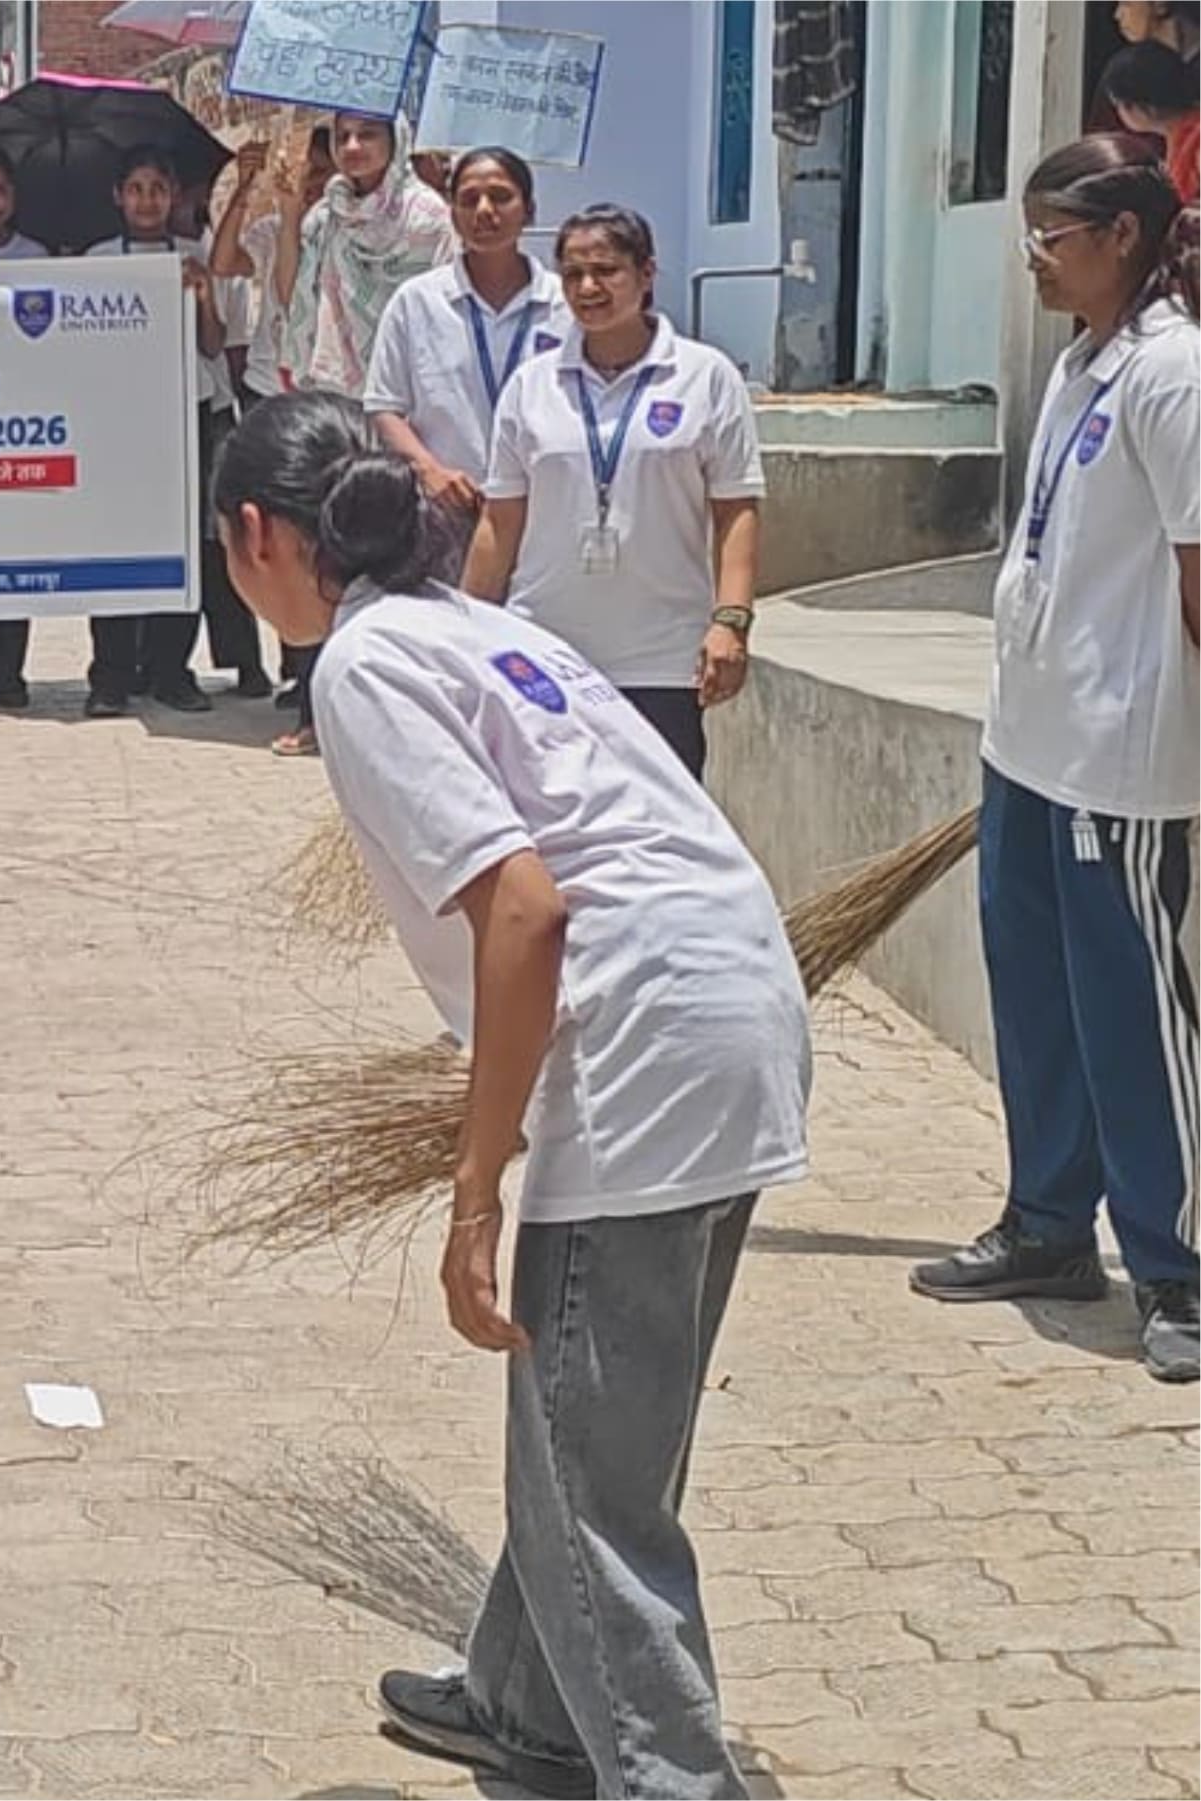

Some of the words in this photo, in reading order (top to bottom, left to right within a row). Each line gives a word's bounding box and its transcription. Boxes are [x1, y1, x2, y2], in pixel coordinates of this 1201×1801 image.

[60, 294, 148, 317] RAMA
[60, 318, 148, 331] UNIVERSITY
[16, 462, 47, 481] तक
